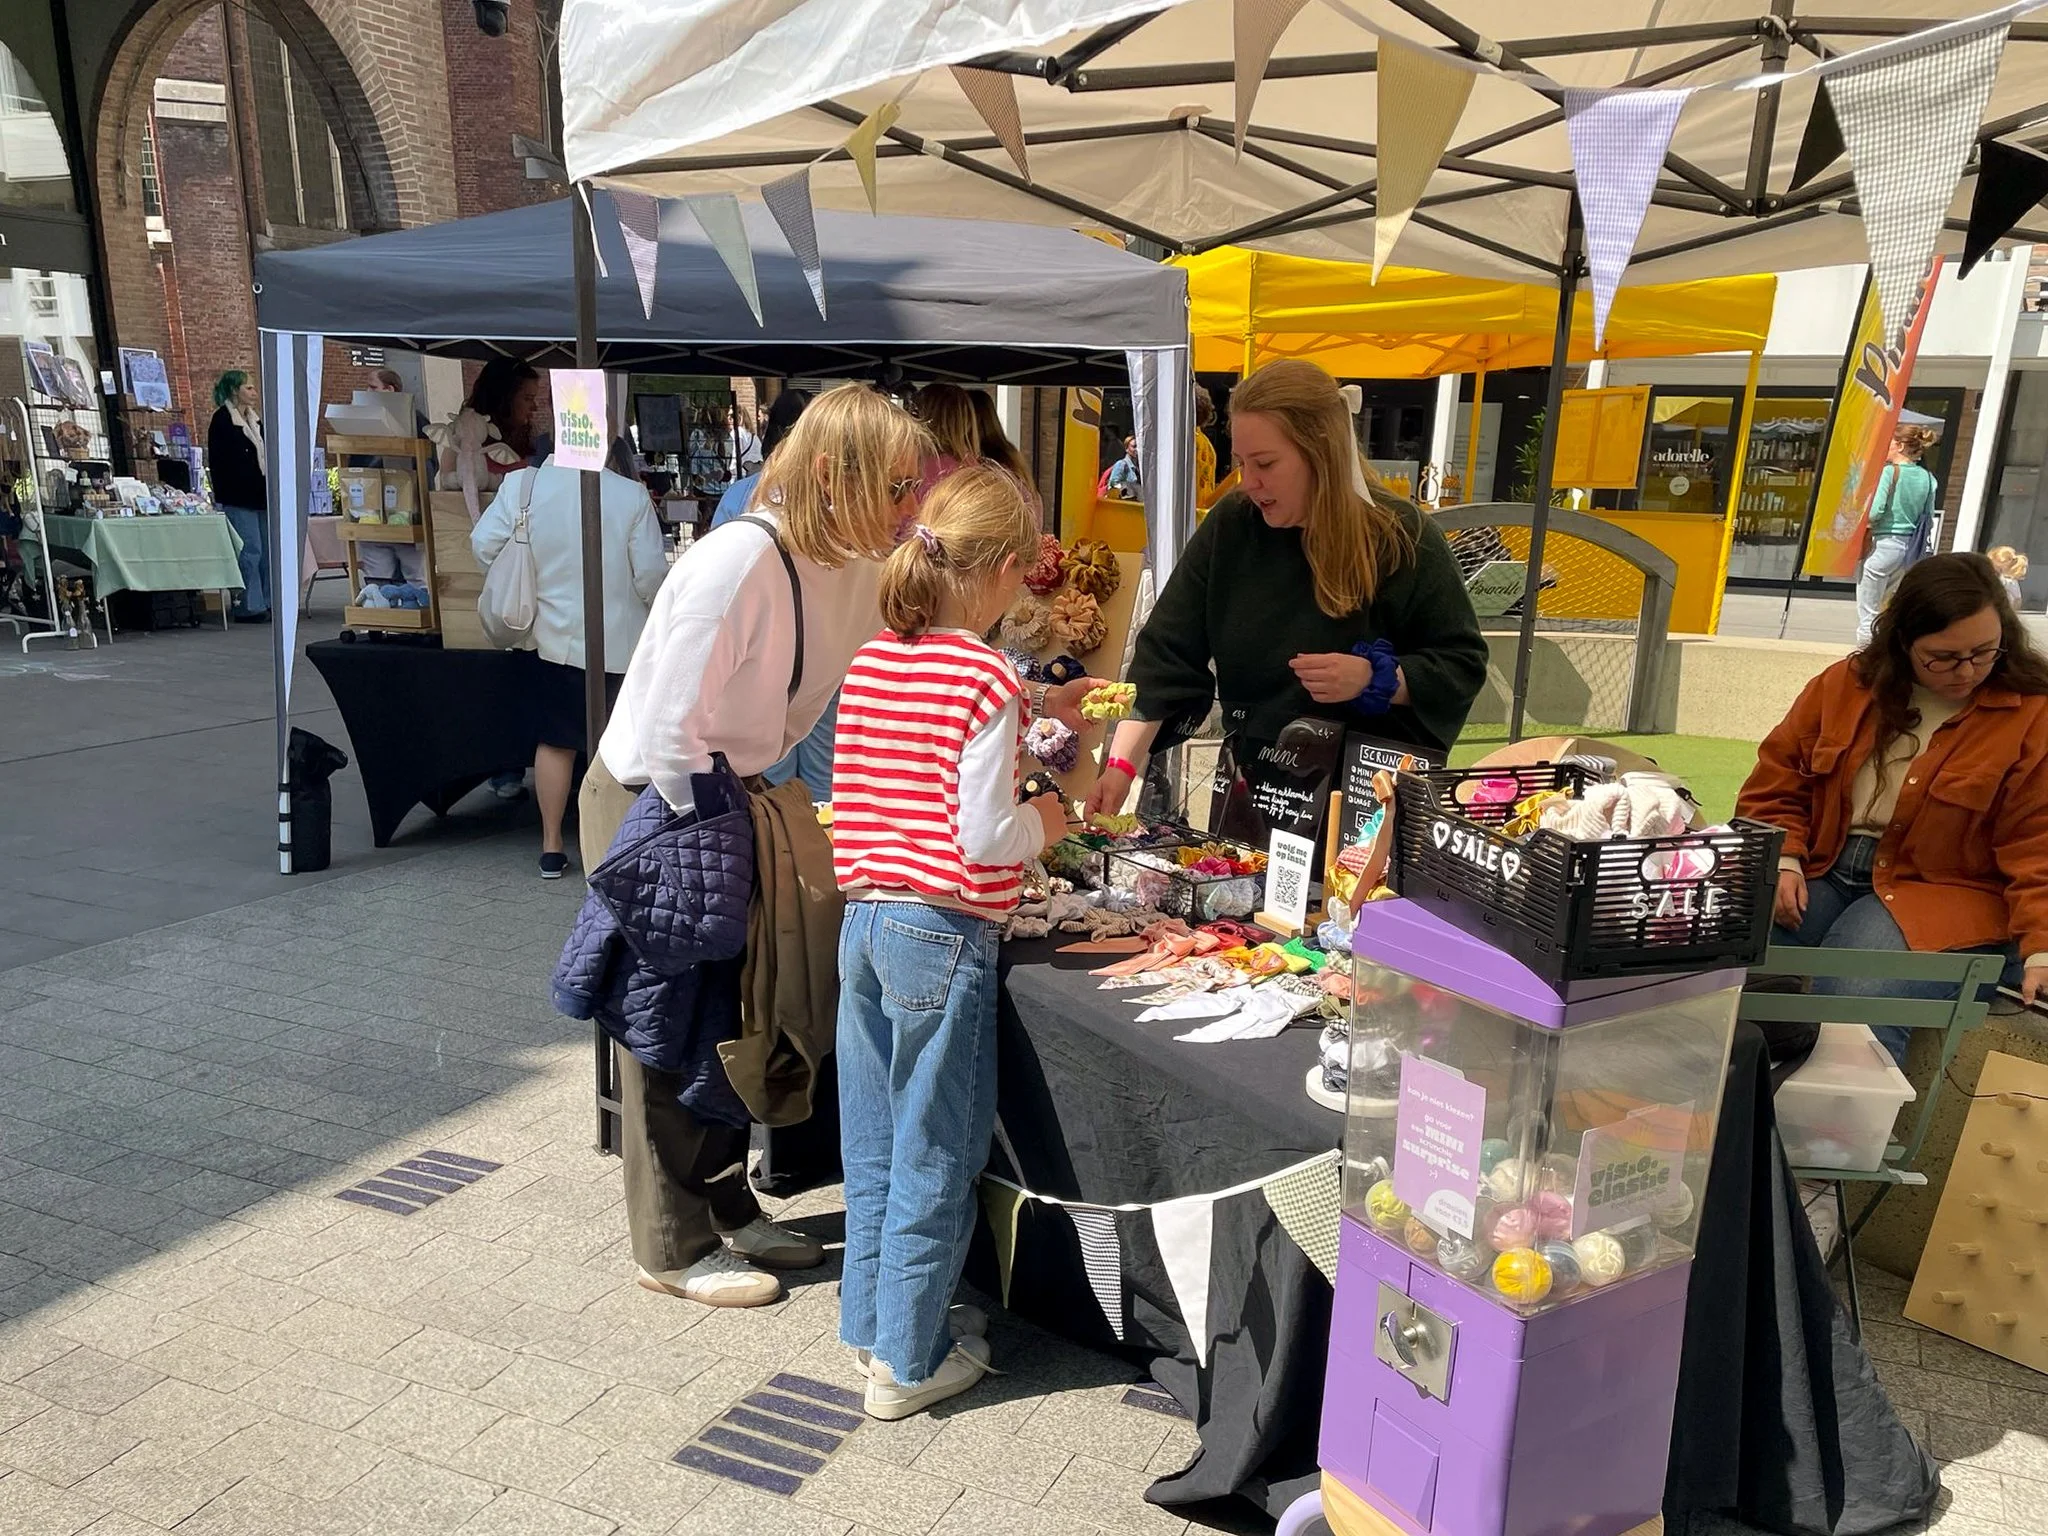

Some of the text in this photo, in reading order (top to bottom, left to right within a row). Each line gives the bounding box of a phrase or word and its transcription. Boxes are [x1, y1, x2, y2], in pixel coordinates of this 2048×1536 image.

[561, 428, 600, 449] elastic
[1652, 447, 1710, 462] adorelle
[1257, 742, 1299, 768] mini
[1363, 748, 1425, 770] SCRUNCS
[1357, 767, 1373, 778] MINI
[1353, 796, 1372, 807] LARGE
[1354, 786, 1376, 798] REGULA
[1276, 850, 1307, 867] op insta
[1277, 842, 1308, 858] volg me
[1450, 829, 1503, 872] SALE
[1631, 887, 1728, 920] SALE
[1402, 1138, 1470, 1181] surprise
[1587, 1167, 1671, 1208] elastic
